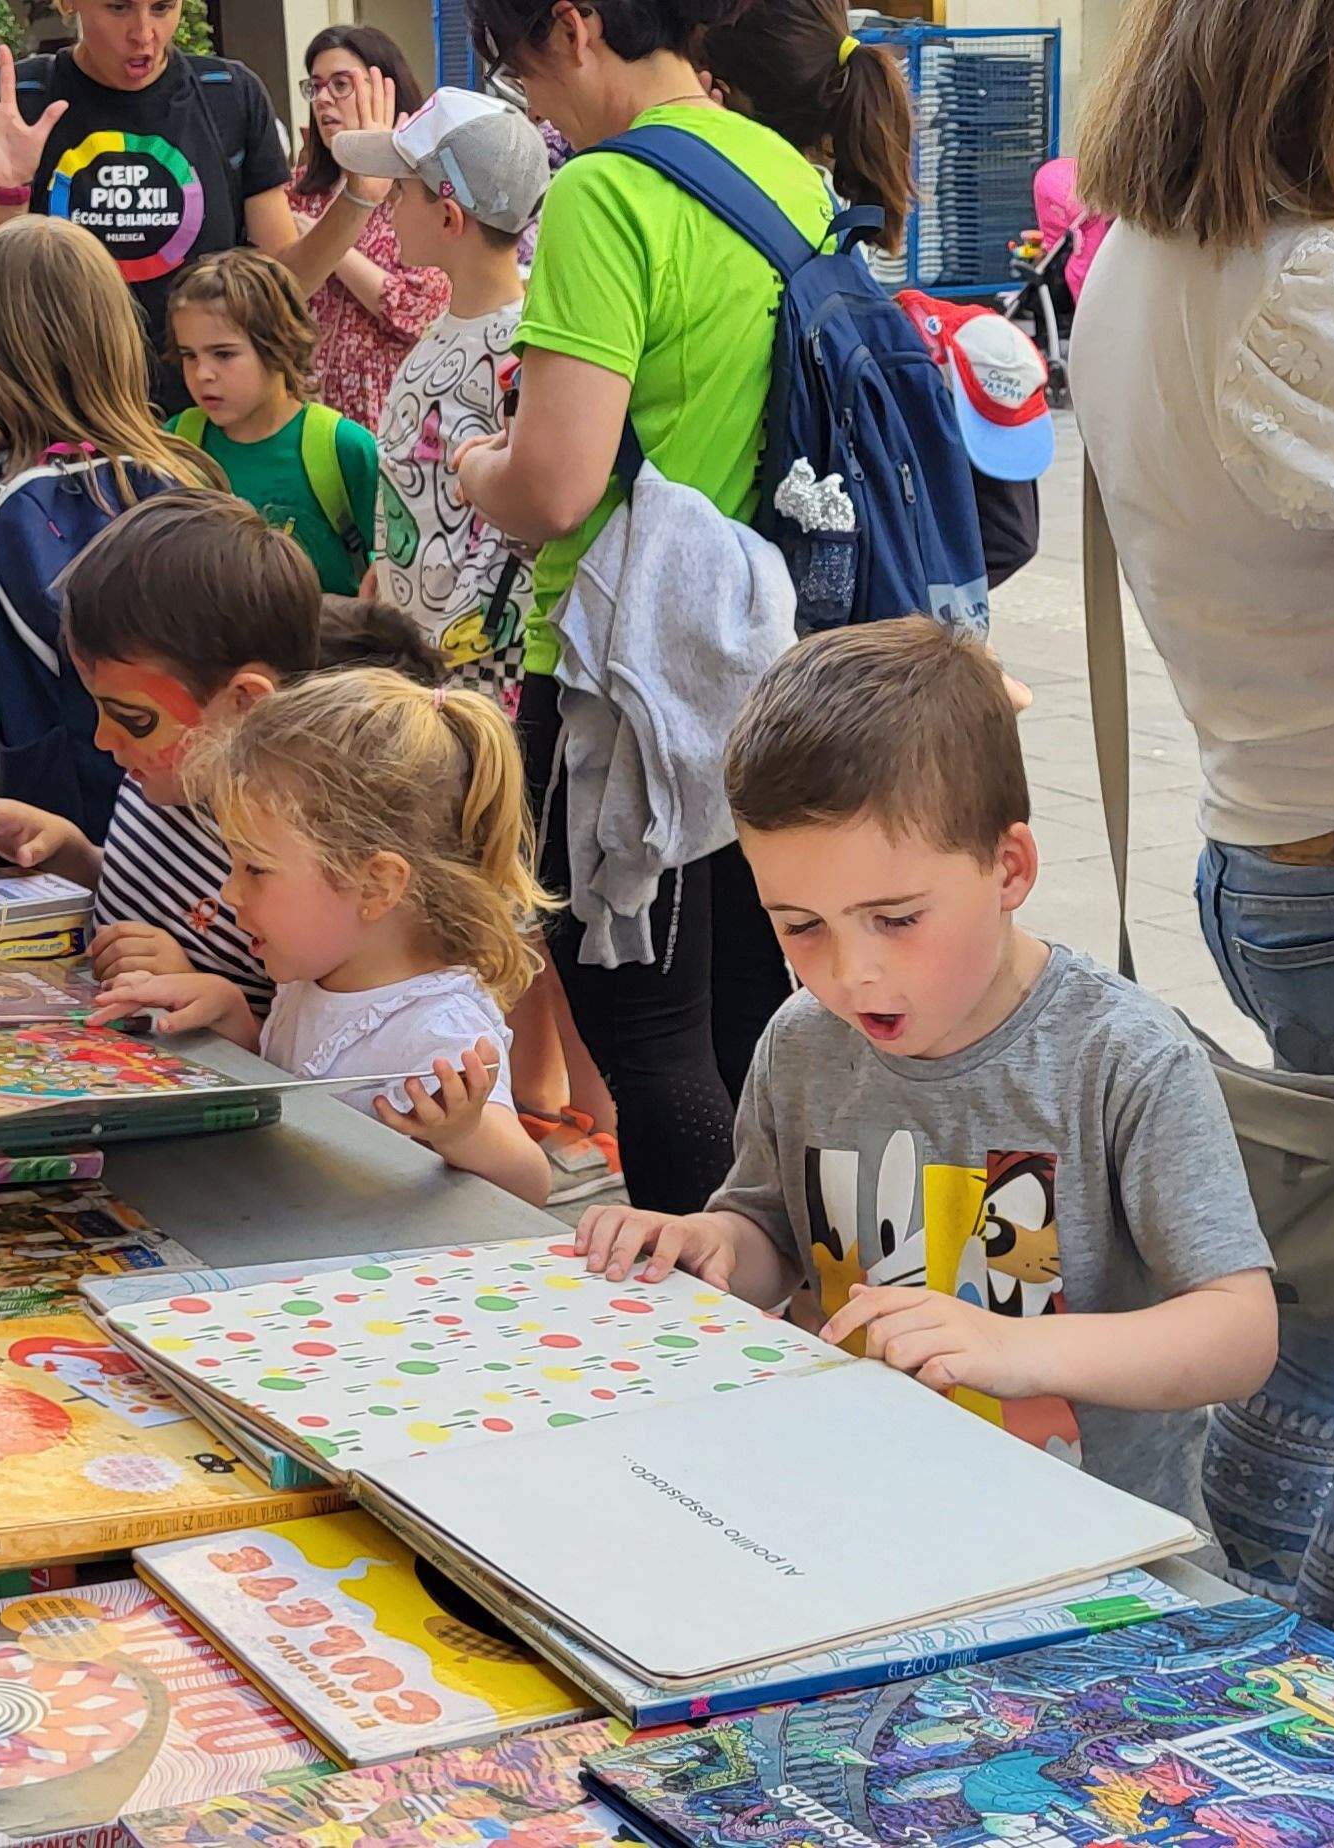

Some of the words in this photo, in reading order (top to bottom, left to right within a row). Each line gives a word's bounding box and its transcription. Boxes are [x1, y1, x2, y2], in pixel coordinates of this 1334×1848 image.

[97, 165, 149, 187] CEIP
[90, 187, 133, 210] PIO
[136, 187, 168, 210] XII
[71, 207, 114, 227] ÉCOLE
[115, 212, 180, 227] BILINGUE
[105, 232, 145, 242] HUESCA
[622, 1454, 724, 1527] despistado...
[98, 1522, 119, 1541] ARTE
[181, 1514, 194, 1531] 25
[723, 1528, 786, 1565] pollito
[776, 1563, 806, 1577] Al
[207, 1546, 443, 1725] CULETE
[887, 1664, 899, 1679] EL
[901, 1653, 938, 1678] ZOO
[944, 1647, 980, 1672] JAIME
[349, 1713, 383, 1730] El
